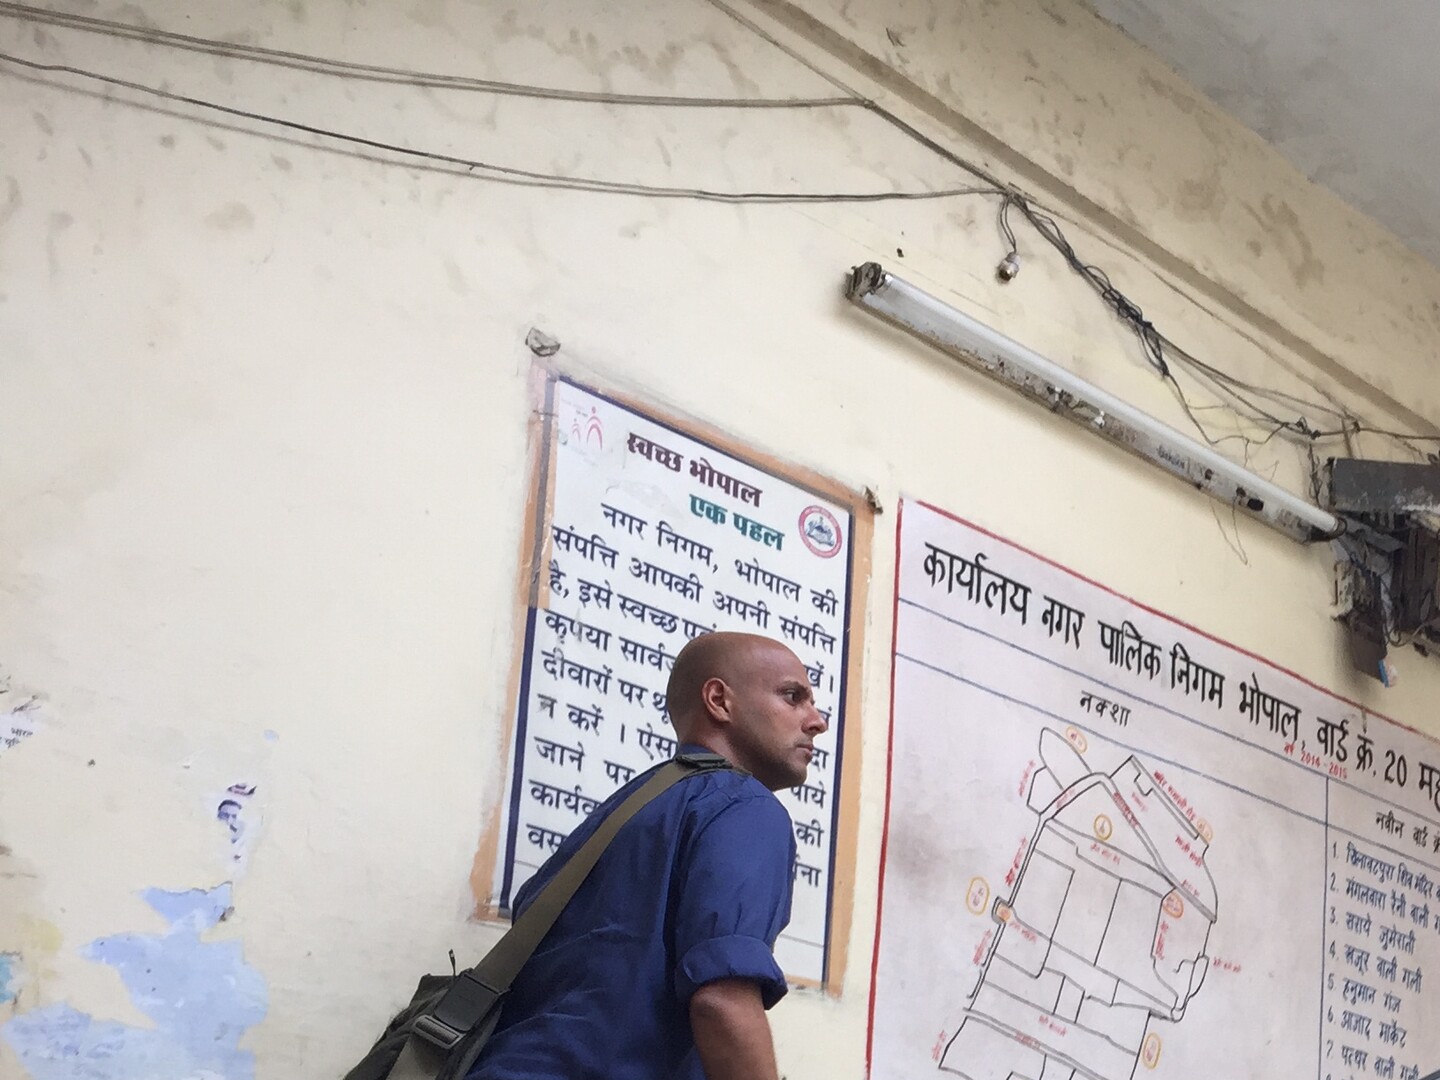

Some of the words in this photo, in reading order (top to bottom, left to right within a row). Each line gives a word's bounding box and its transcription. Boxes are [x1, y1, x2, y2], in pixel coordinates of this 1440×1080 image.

[626, 431, 684, 473] स्वच्छ
[689, 458, 763, 508] भोपाल
[689, 494, 727, 526] एक
[733, 513, 786, 551] पहल
[601, 503, 648, 540] नगर
[656, 521, 719, 574] निगम,
[734, 558, 802, 604] भोपाल
[810, 588, 839, 617] की
[551, 525, 621, 569] संपत्ति
[628, 557, 704, 603] आपकी
[712, 589, 772, 630] अपनी
[778, 615, 836, 655] संपत्ति
[577, 577, 614, 611] इसे
[617, 593, 679, 634] स्वच्छ
[545, 608, 612, 648] कृपया
[541, 647, 613, 695] दीवारों
[618, 678, 649, 709] पर
[923, 542, 1032, 626] कार्यालय
[1042, 595, 1085, 650] नगर
[1098, 620, 1162, 680] पालिक
[1169, 642, 1225, 709] निगम
[1316, 716, 1348, 762] वार्ड
[1384, 750, 1408, 788] 20
[566, 703, 604, 736] करें
[534, 736, 585, 773] जाने
[603, 760, 637, 785] पर
[1376, 810, 1405, 838] नवीन
[1342, 977, 1377, 1006] हनुमान
[1376, 956, 1398, 983] वाली
[1402, 966, 1423, 994] गली
[1341, 1009, 1372, 1041] आजाद
[1374, 1055, 1395, 1080] वाली
